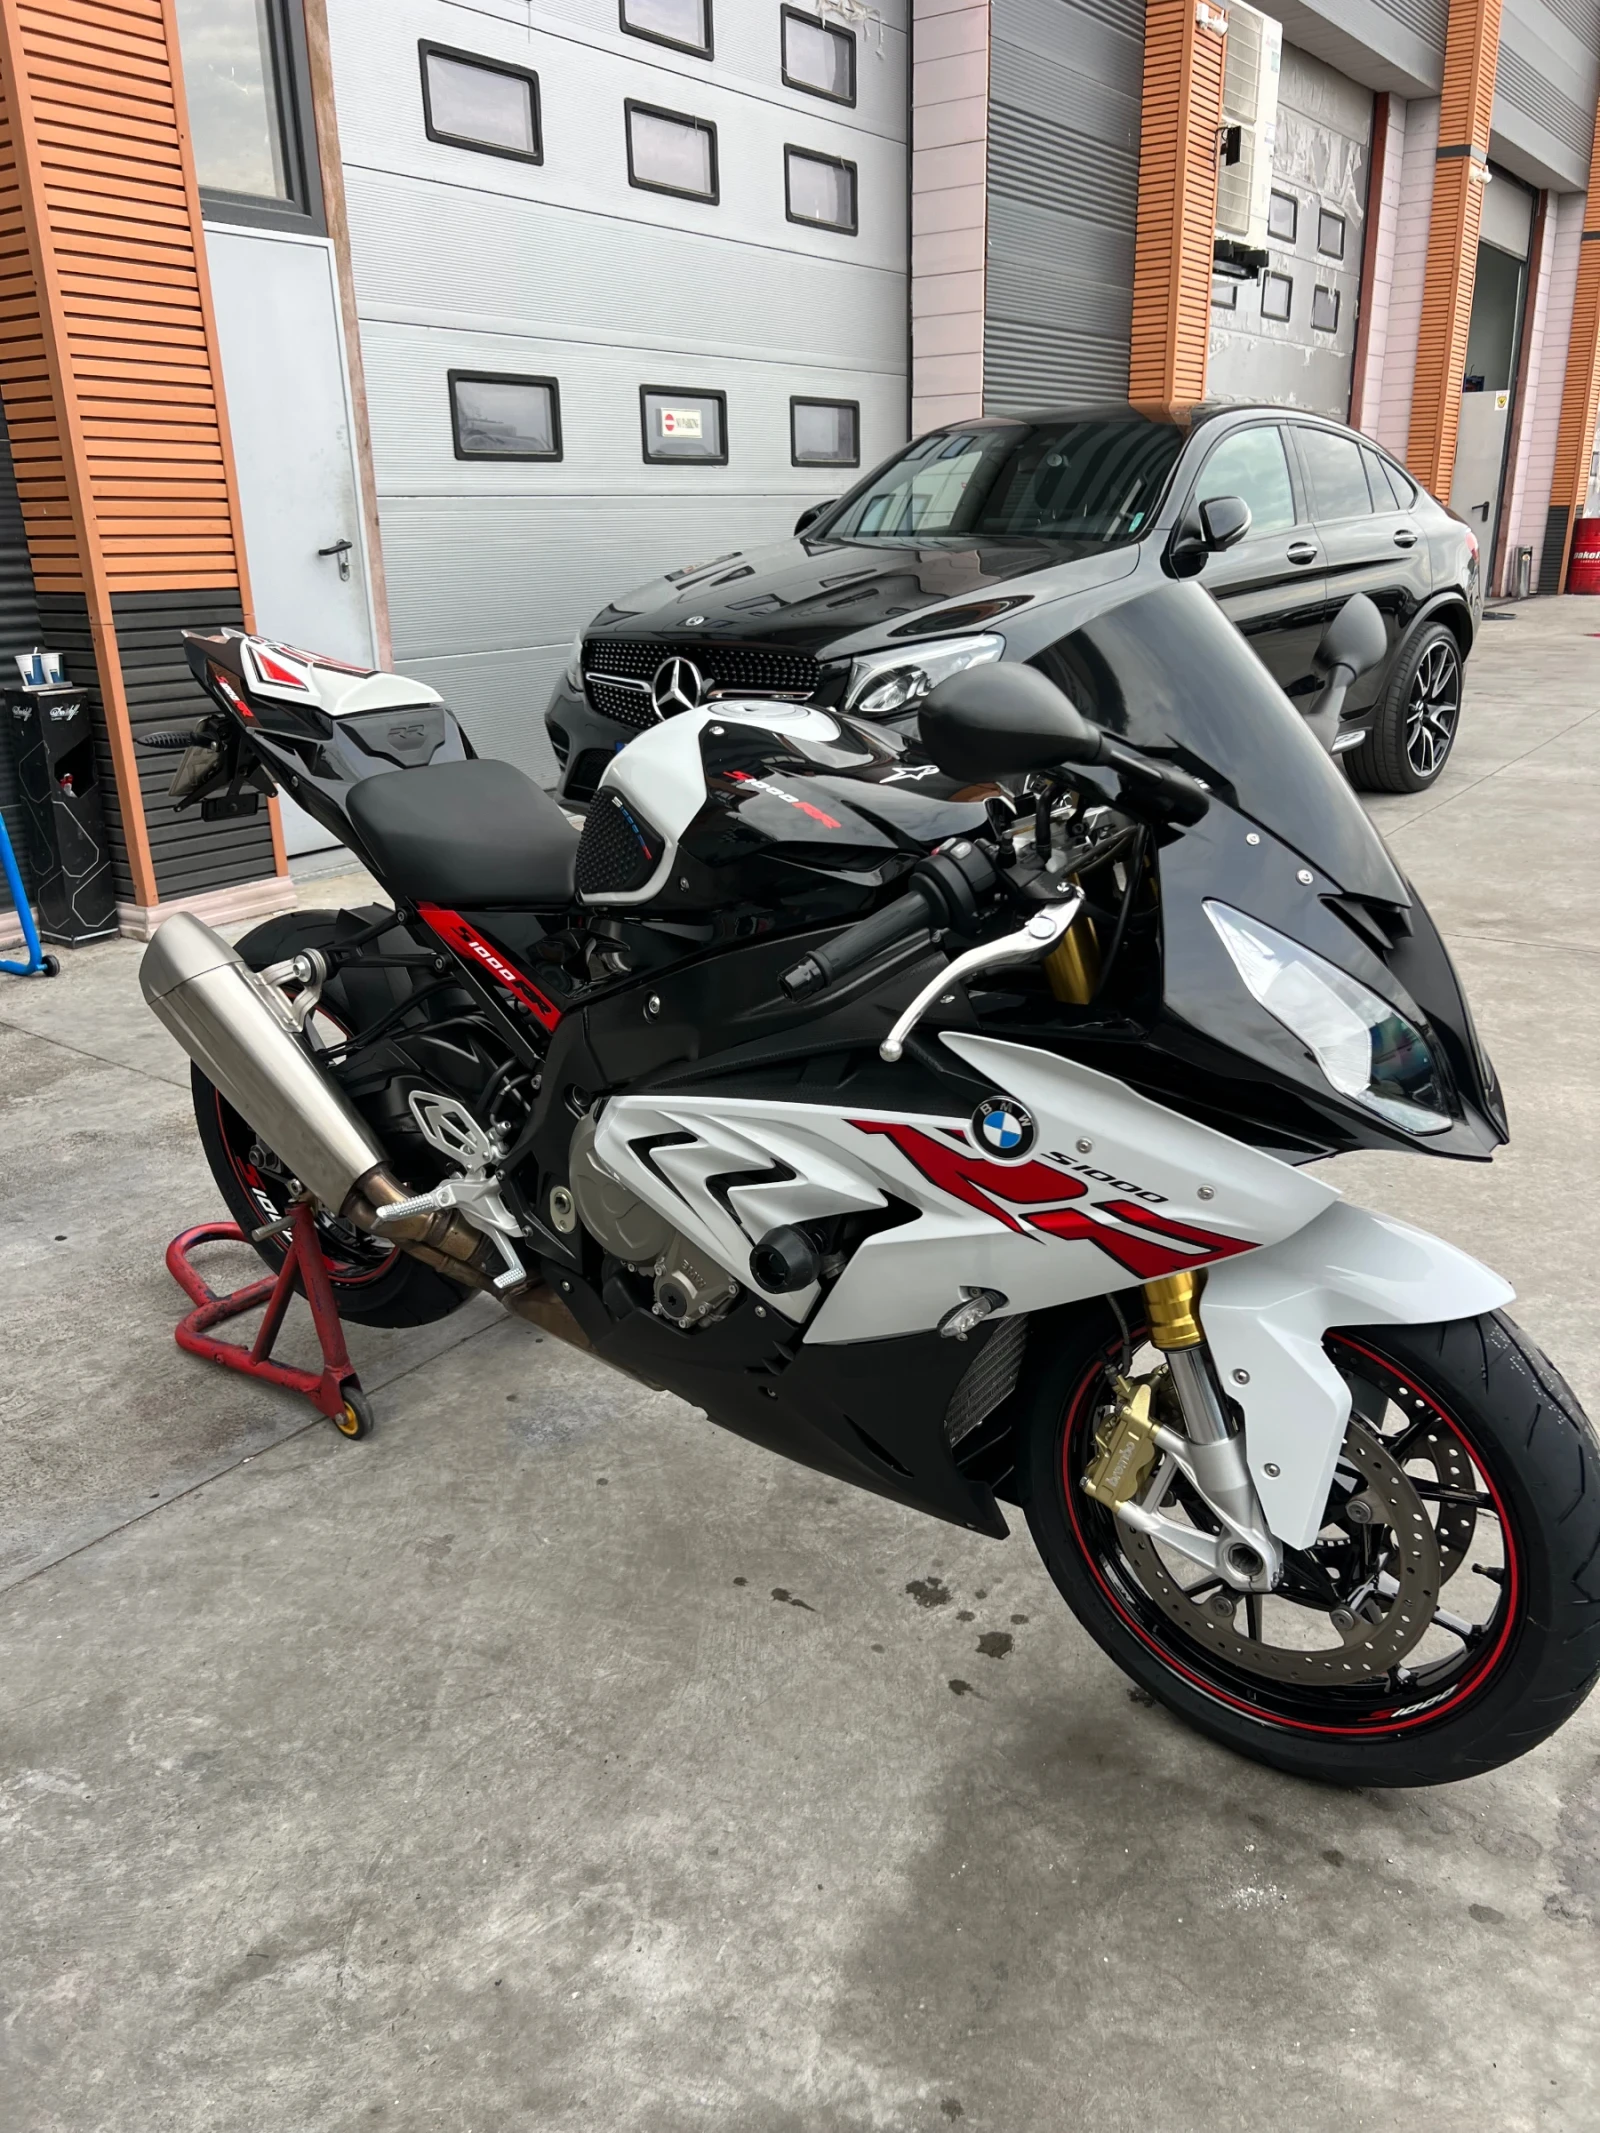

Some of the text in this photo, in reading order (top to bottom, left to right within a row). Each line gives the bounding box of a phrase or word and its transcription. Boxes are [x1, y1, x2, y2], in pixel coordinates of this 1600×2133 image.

[979, 1101, 1031, 1128] BMW
[1040, 1151, 1169, 1202] S1000
[1105, 1441, 1135, 1487] brembo
